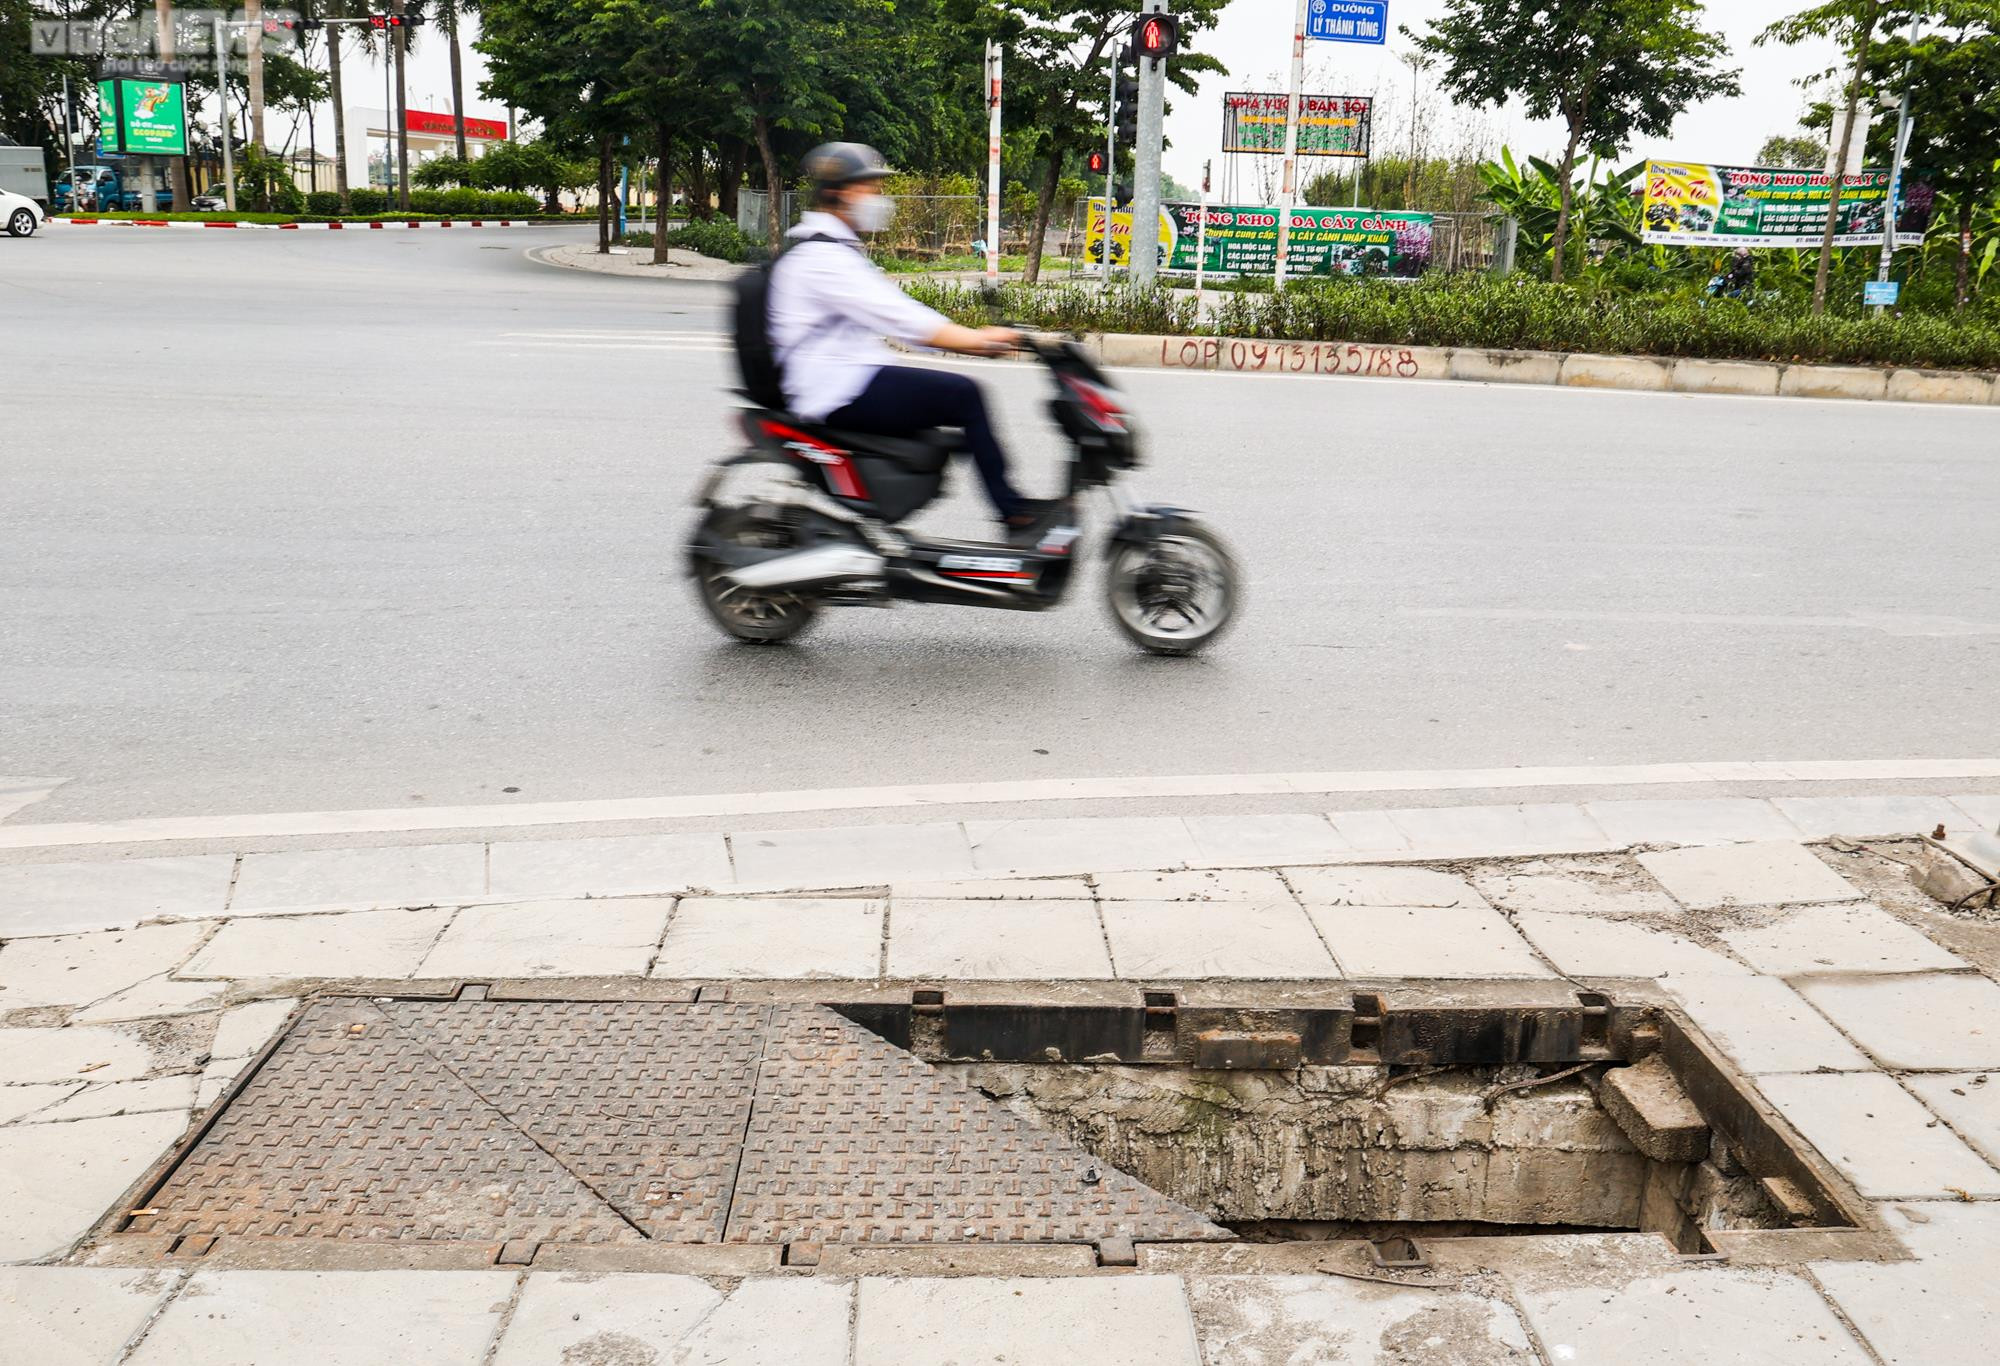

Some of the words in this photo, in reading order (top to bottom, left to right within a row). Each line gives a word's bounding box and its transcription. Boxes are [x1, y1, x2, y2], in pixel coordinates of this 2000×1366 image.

[1313, 15, 1323, 33] LÝ
[1325, 16, 1354, 35] THÁNH
[1775, 174, 1806, 186] KHO
[1237, 213, 1275, 226] KHO
[1321, 214, 1357, 230] CÂY
[1361, 215, 1408, 231] CẢNH
